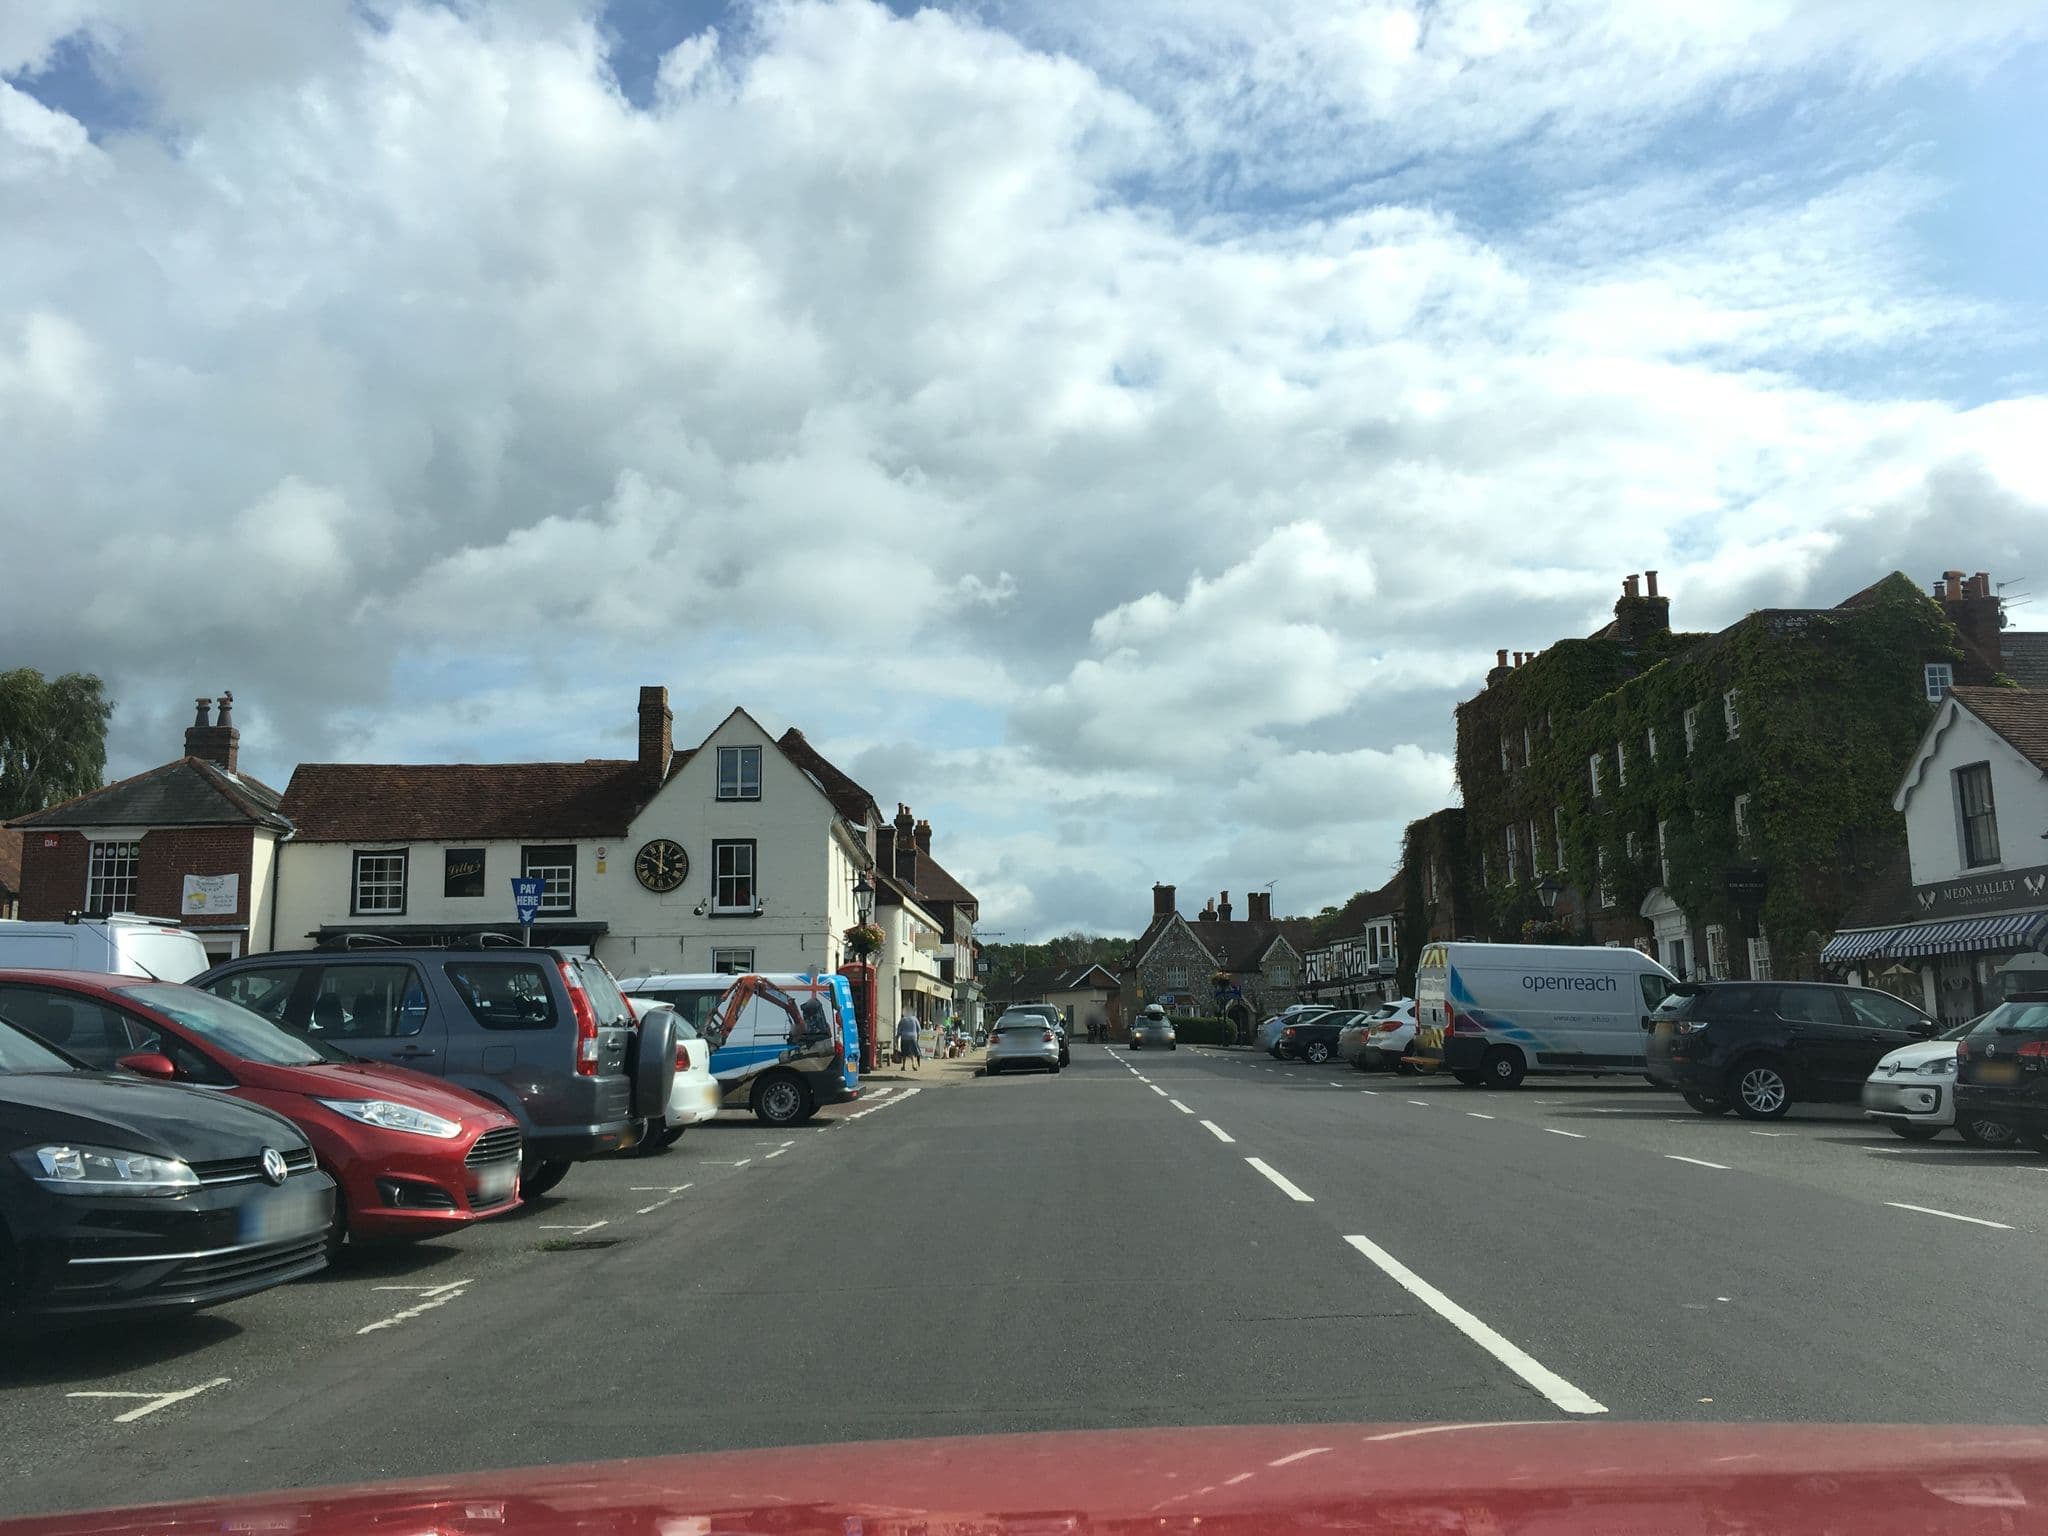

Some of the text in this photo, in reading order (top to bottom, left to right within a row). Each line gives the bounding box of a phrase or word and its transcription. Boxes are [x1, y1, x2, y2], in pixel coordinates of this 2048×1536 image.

[520, 883, 536, 894] PAY
[1944, 879, 2016, 900] MEON VALLEY
[517, 896, 539, 906] HERE
[1522, 975, 1617, 992] openreach
